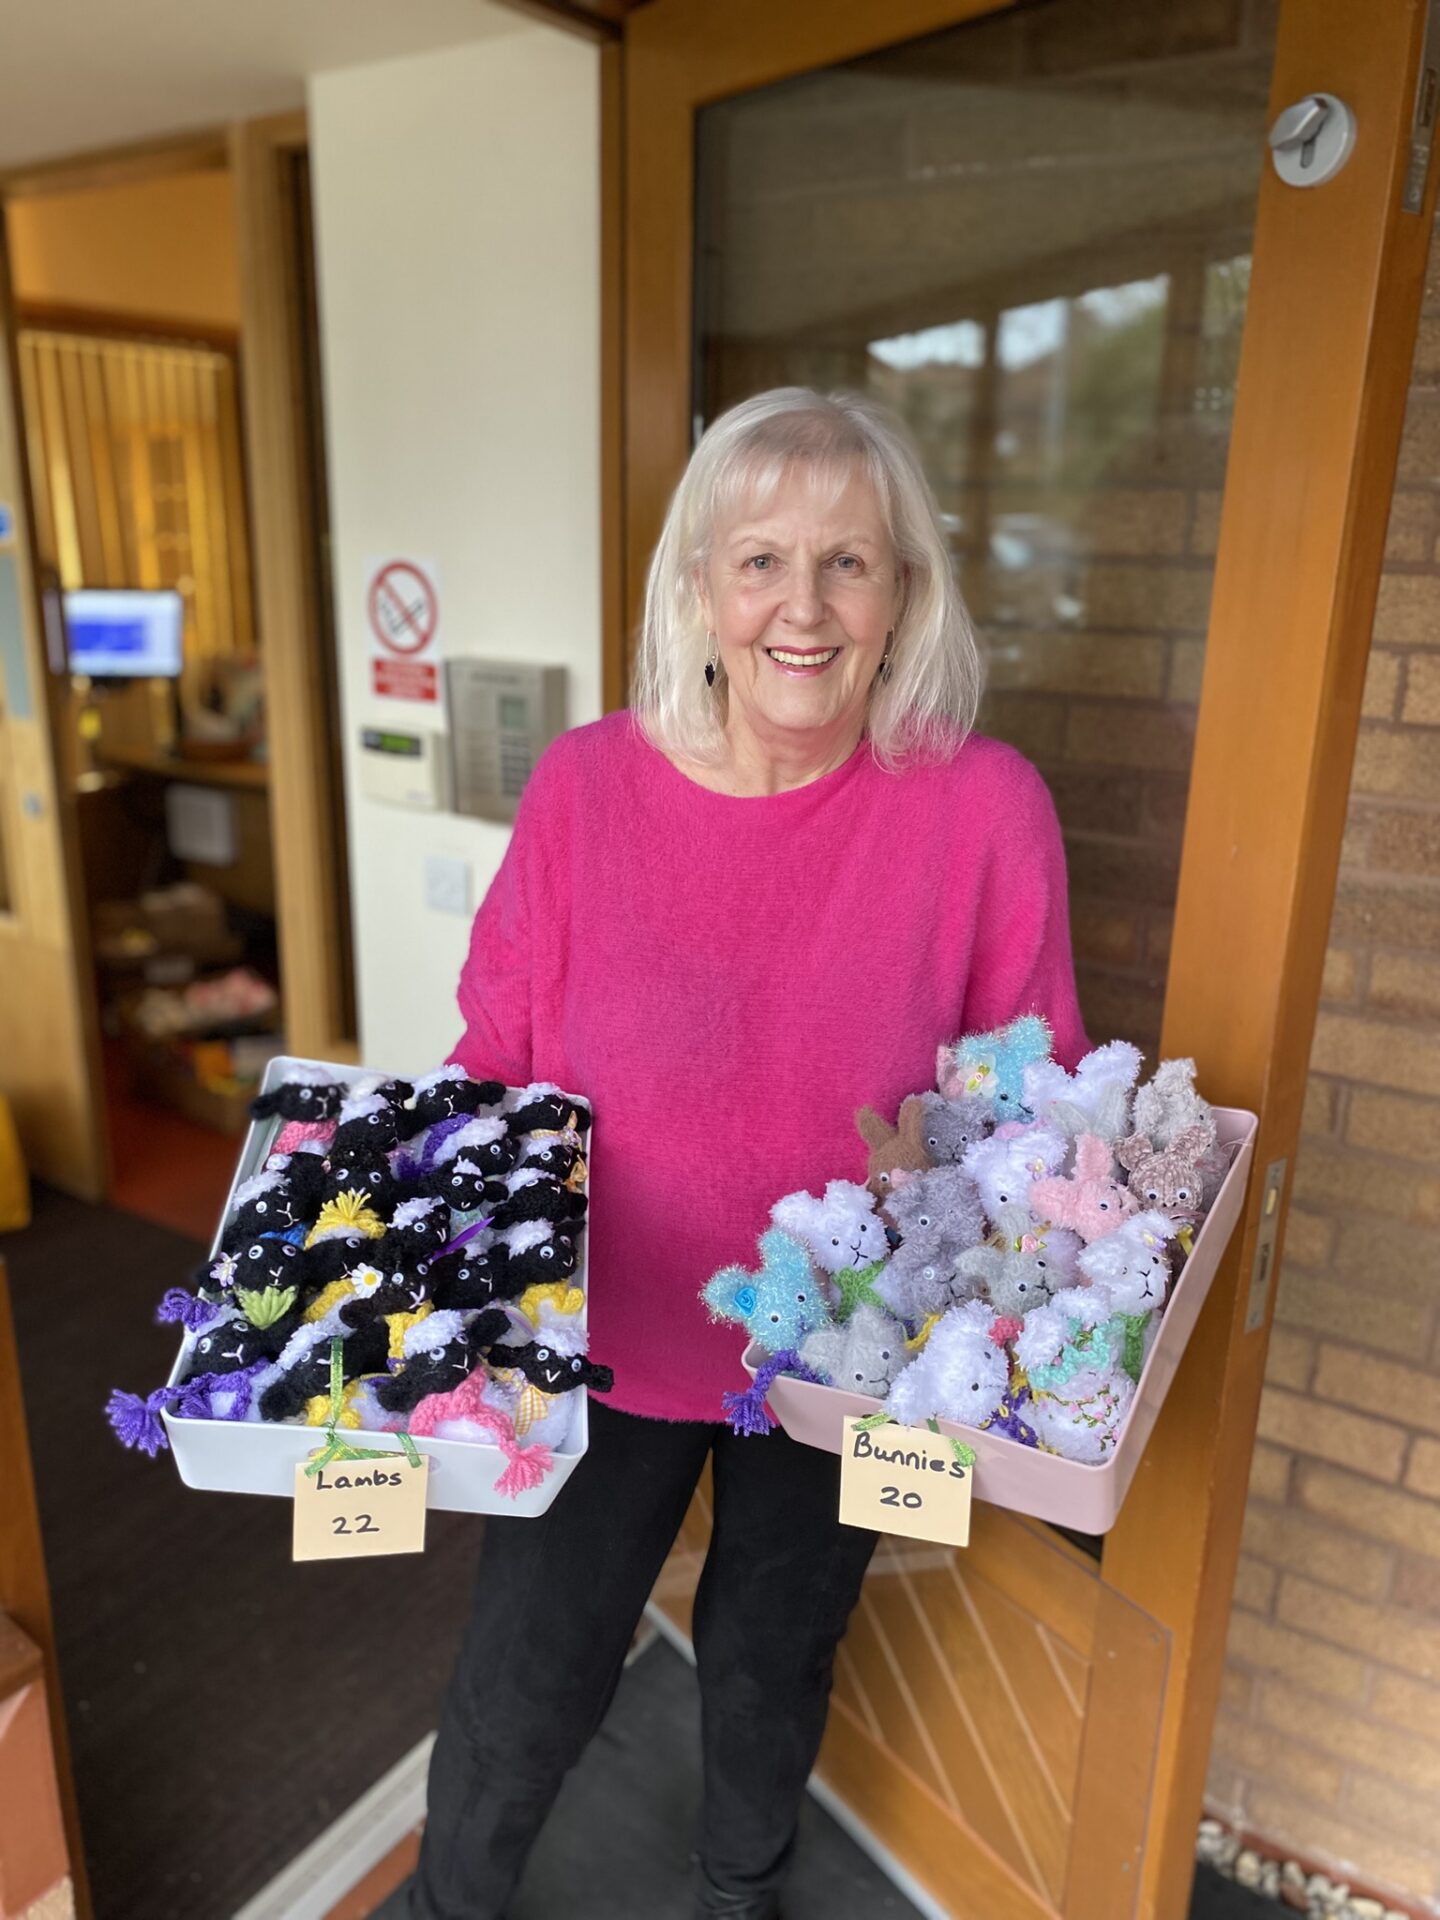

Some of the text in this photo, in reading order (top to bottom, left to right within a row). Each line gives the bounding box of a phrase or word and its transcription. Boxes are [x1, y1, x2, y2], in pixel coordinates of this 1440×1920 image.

[853, 1431, 966, 1479] Bunnies
[316, 1469, 402, 1490] Lambs
[879, 1486, 923, 1509] 20
[332, 1514, 380, 1534] 22
